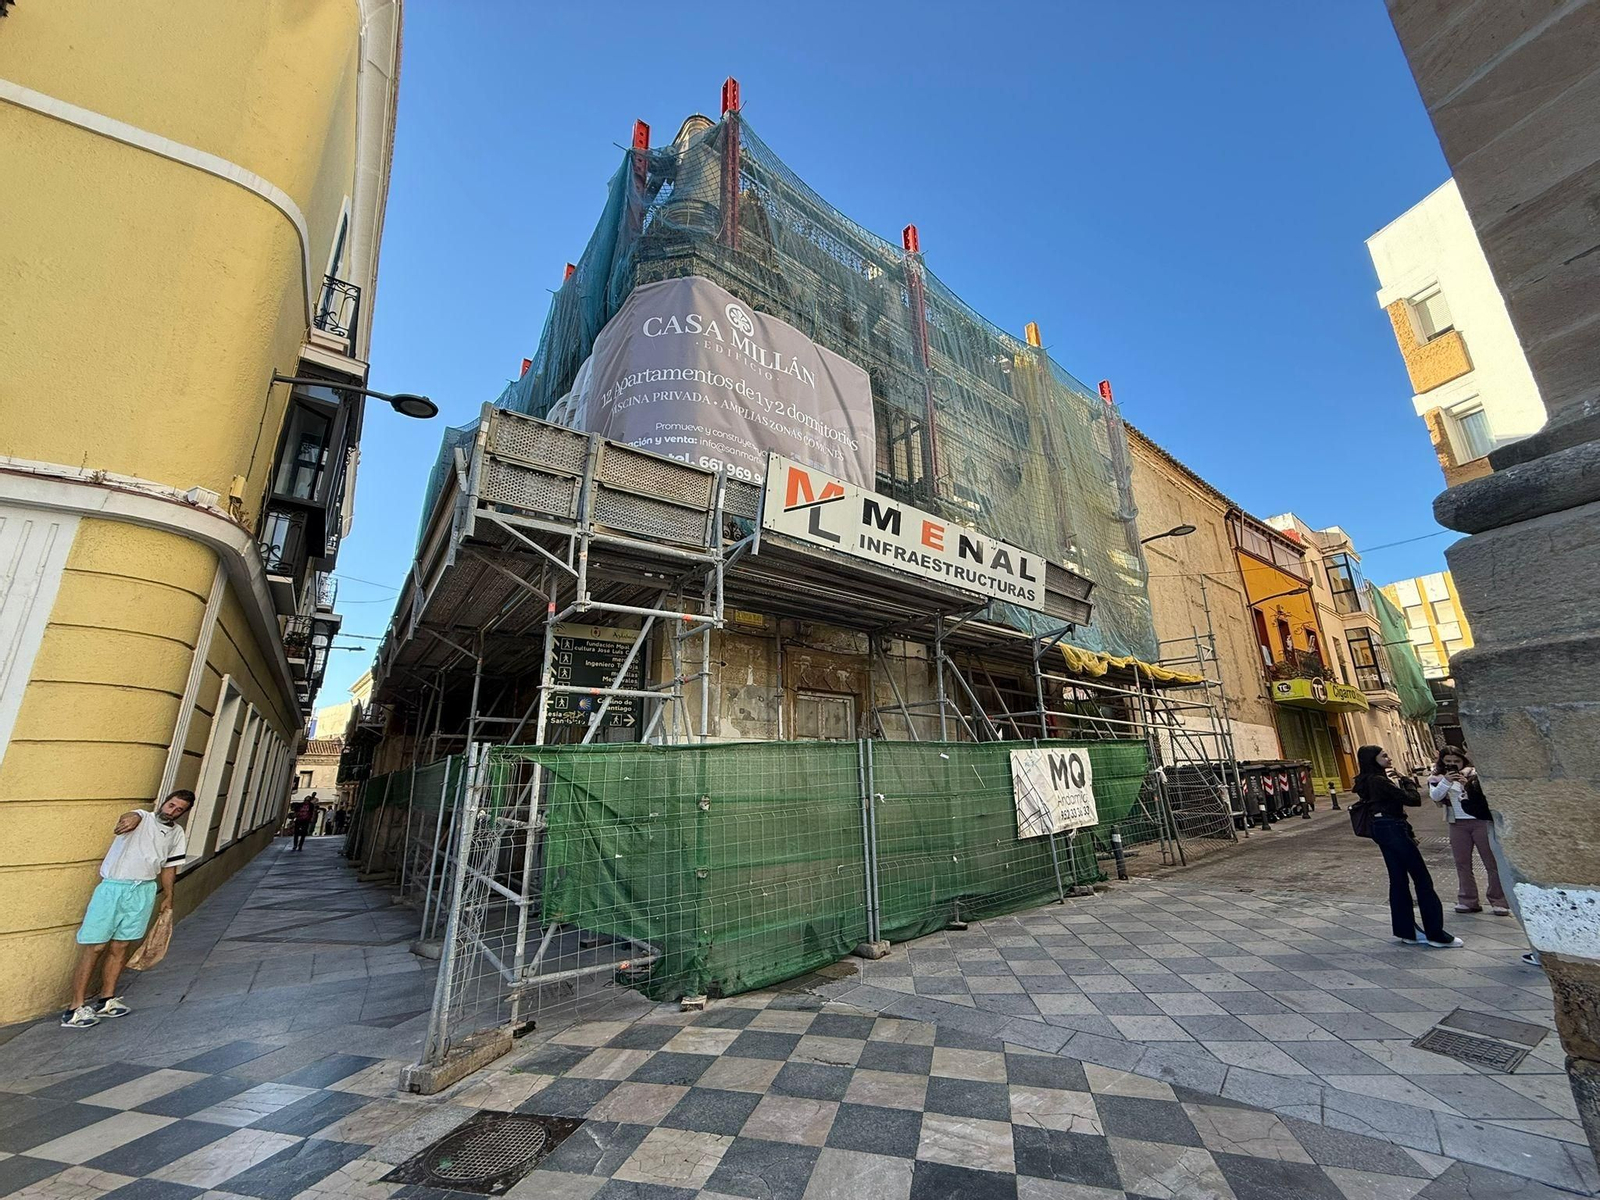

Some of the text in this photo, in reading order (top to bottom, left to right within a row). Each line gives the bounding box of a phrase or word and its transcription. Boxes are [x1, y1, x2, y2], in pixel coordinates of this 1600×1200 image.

[643, 313, 816, 389] CASA MILLÁN
[704, 340, 773, 381] EDIFICIO
[601, 389, 613, 409] 12
[614, 367, 734, 399] Apartamentos
[735, 379, 755, 401] de
[755, 391, 763, 406] 1
[763, 397, 774, 413] y
[775, 400, 785, 416] 2
[652, 390, 711, 406] PRIVADA
[720, 399, 769, 427] AMPLIAS
[769, 420, 803, 442] ZONAS
[803, 433, 845, 463] COMUNES
[655, 436, 662, 446] y
[664, 435, 698, 446] venta:
[656, 421, 704, 433] Promueve
[704, 427, 712, 436] y
[699, 455, 723, 472] 661
[726, 463, 752, 481] 969
[862, 497, 1036, 583] MENAL
[859, 534, 1036, 603] INFRAESTRUCTURAS
[574, 645, 596, 653] cultura
[585, 659, 615, 668] Ingeniero
[605, 704, 632, 713] antiago
[1047, 752, 1086, 791] MQ
